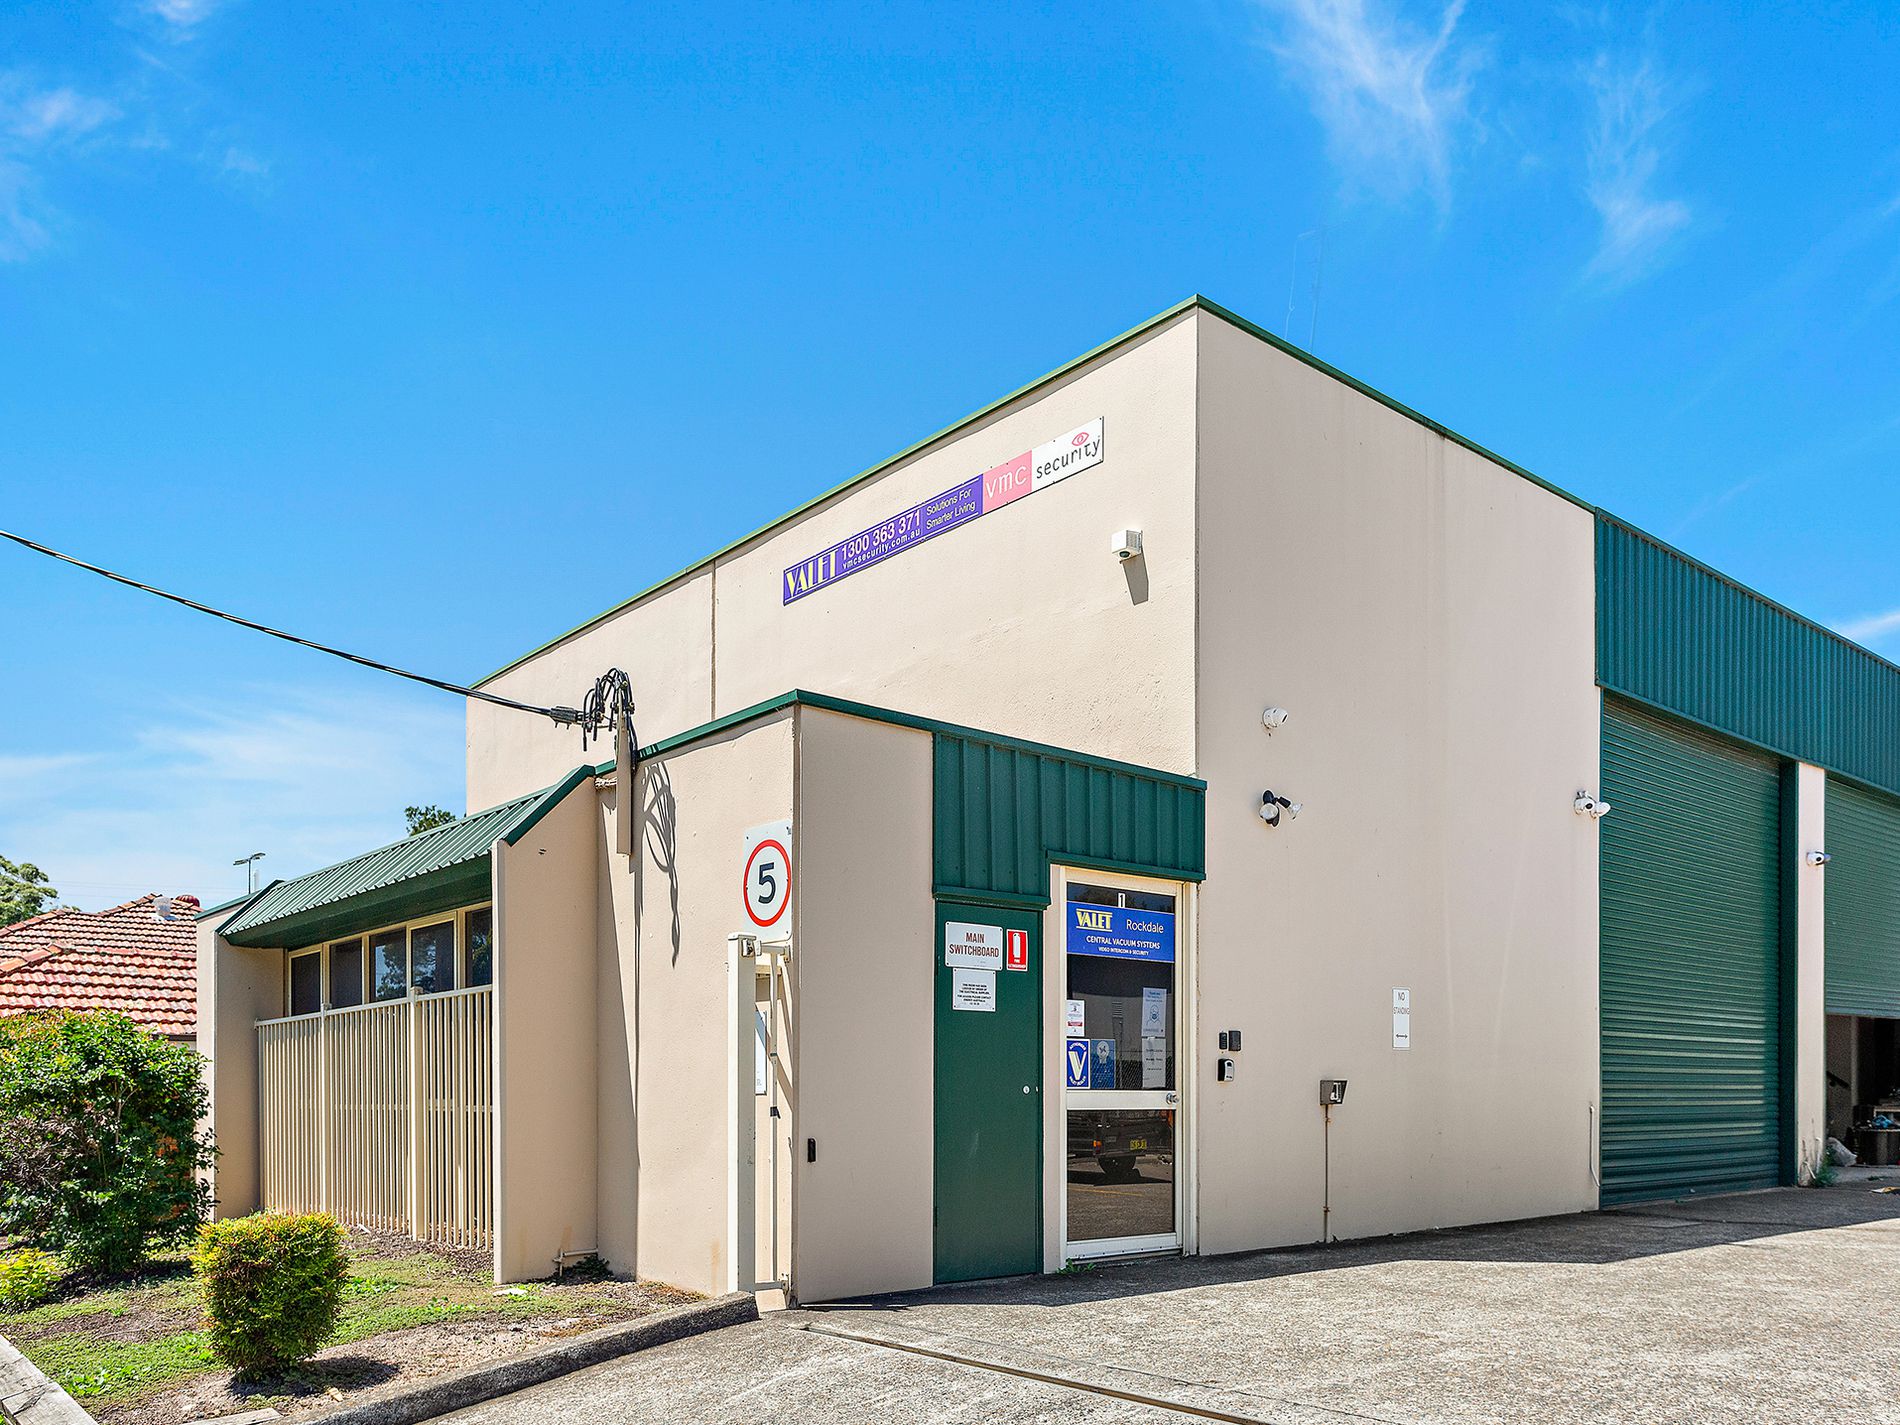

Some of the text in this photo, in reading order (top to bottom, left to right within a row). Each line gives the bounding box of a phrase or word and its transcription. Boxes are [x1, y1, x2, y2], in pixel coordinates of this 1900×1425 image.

[985, 438, 1101, 499] vmc security
[926, 488, 972, 516] Solutions For
[926, 500, 976, 530] Smarter Living
[842, 510, 920, 561] 1300 363 371
[842, 528, 921, 570] vmcsecurity.com.au
[785, 550, 838, 597] VALET
[758, 861, 776, 904] 5
[1076, 911, 1111, 929] VALET
[1126, 919, 1164, 934] Rockdale
[949, 944, 999, 958] SWITCHBOARD
[965, 932, 985, 943] MAIN
[1086, 935, 1160, 949] CENTRAL VACUUM SYSTEMS
[1393, 1006, 1410, 1014] STANDING
[1398, 992, 1405, 1001] NO
[1068, 1051, 1087, 1080] V
